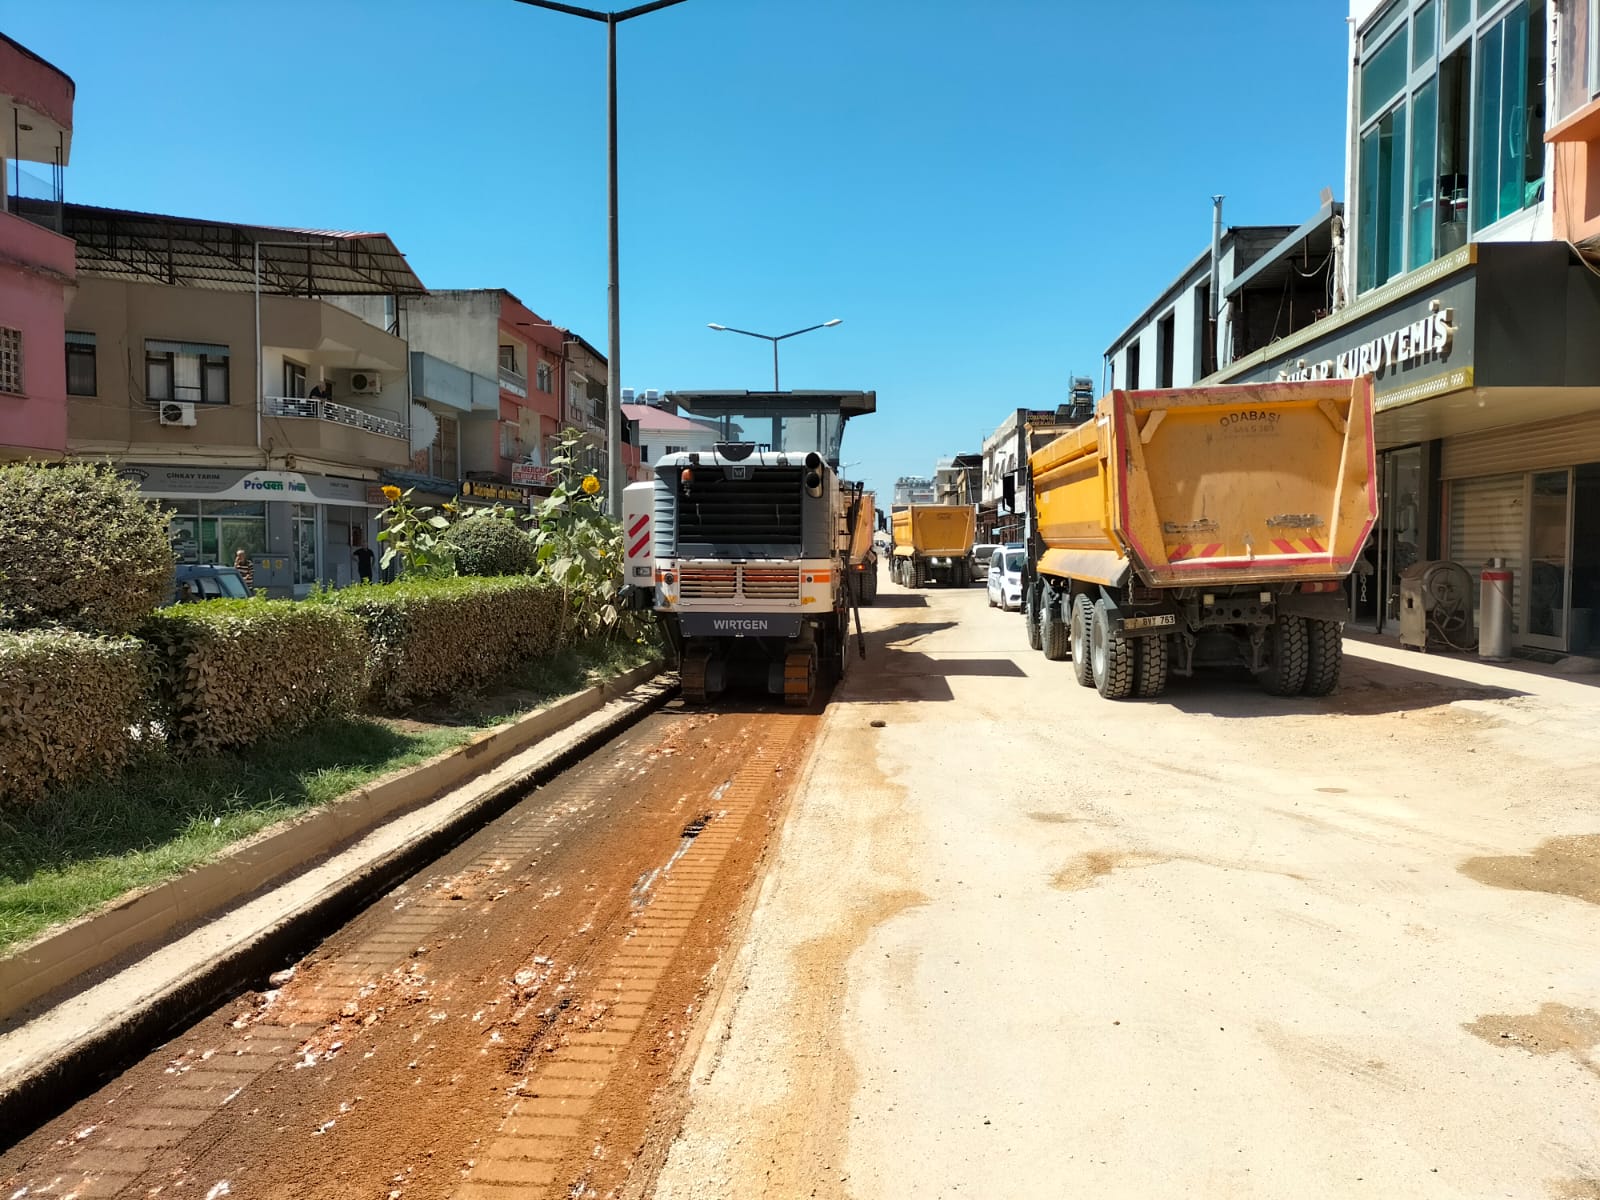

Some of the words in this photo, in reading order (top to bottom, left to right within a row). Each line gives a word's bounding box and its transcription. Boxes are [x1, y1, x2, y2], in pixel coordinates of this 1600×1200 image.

[1336, 299, 1456, 379] KURUYEMİŞ
[243, 480, 284, 490] ProGen
[713, 619, 768, 630] WIRTGEN
